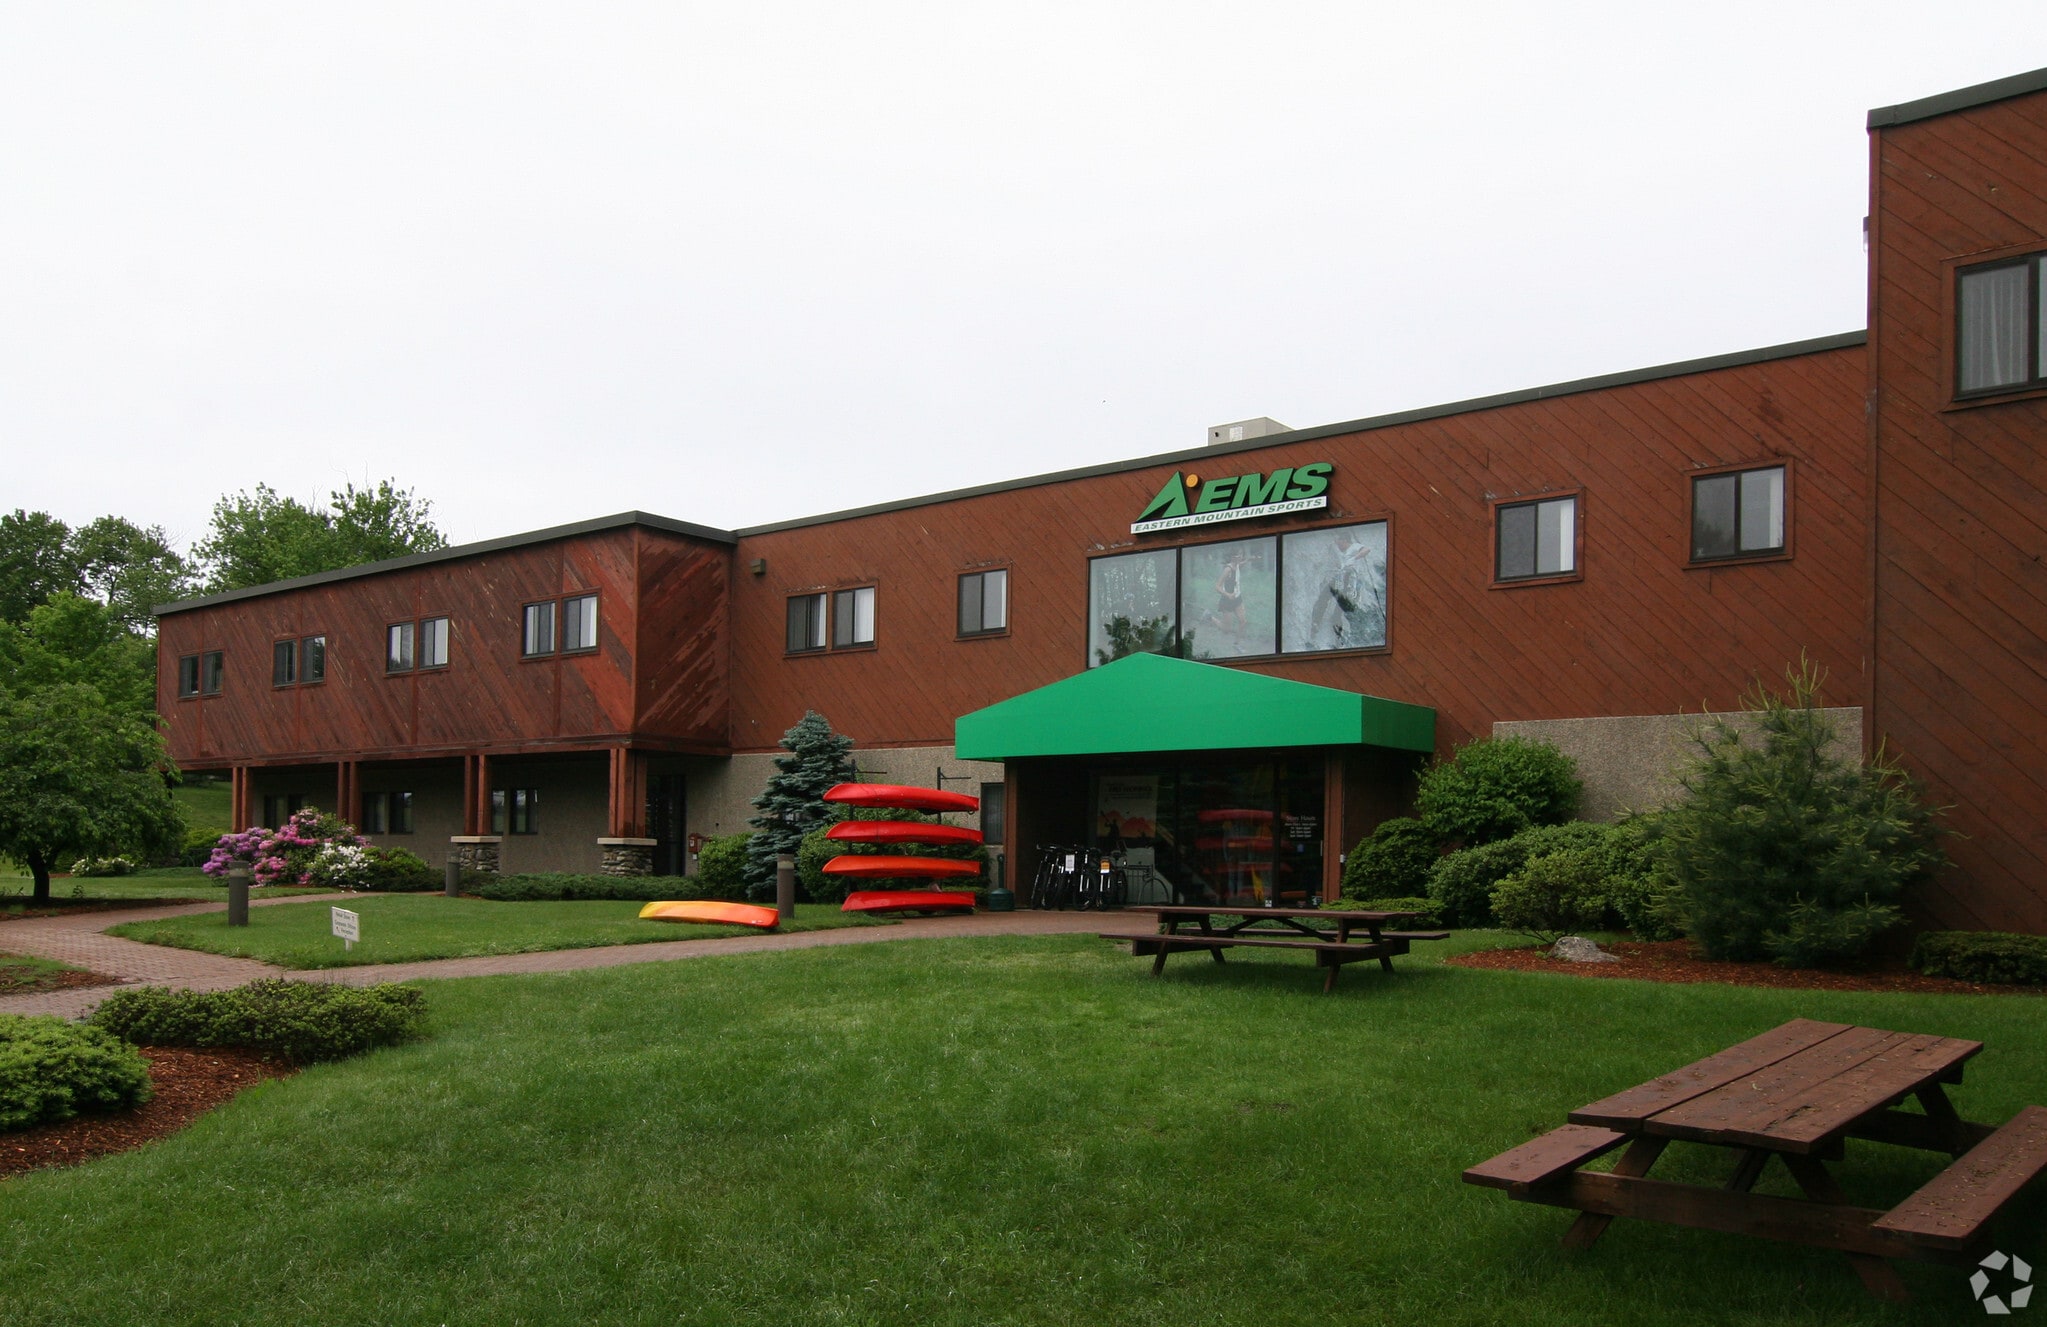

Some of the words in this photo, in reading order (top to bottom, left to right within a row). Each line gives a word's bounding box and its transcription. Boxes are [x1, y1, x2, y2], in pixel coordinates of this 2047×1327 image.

[1194, 462, 1333, 514] EMS
[1134, 517, 1191, 532] EASTERN
[1193, 506, 1265, 524] MOUNTAIN
[1267, 497, 1323, 513] SPORTS
